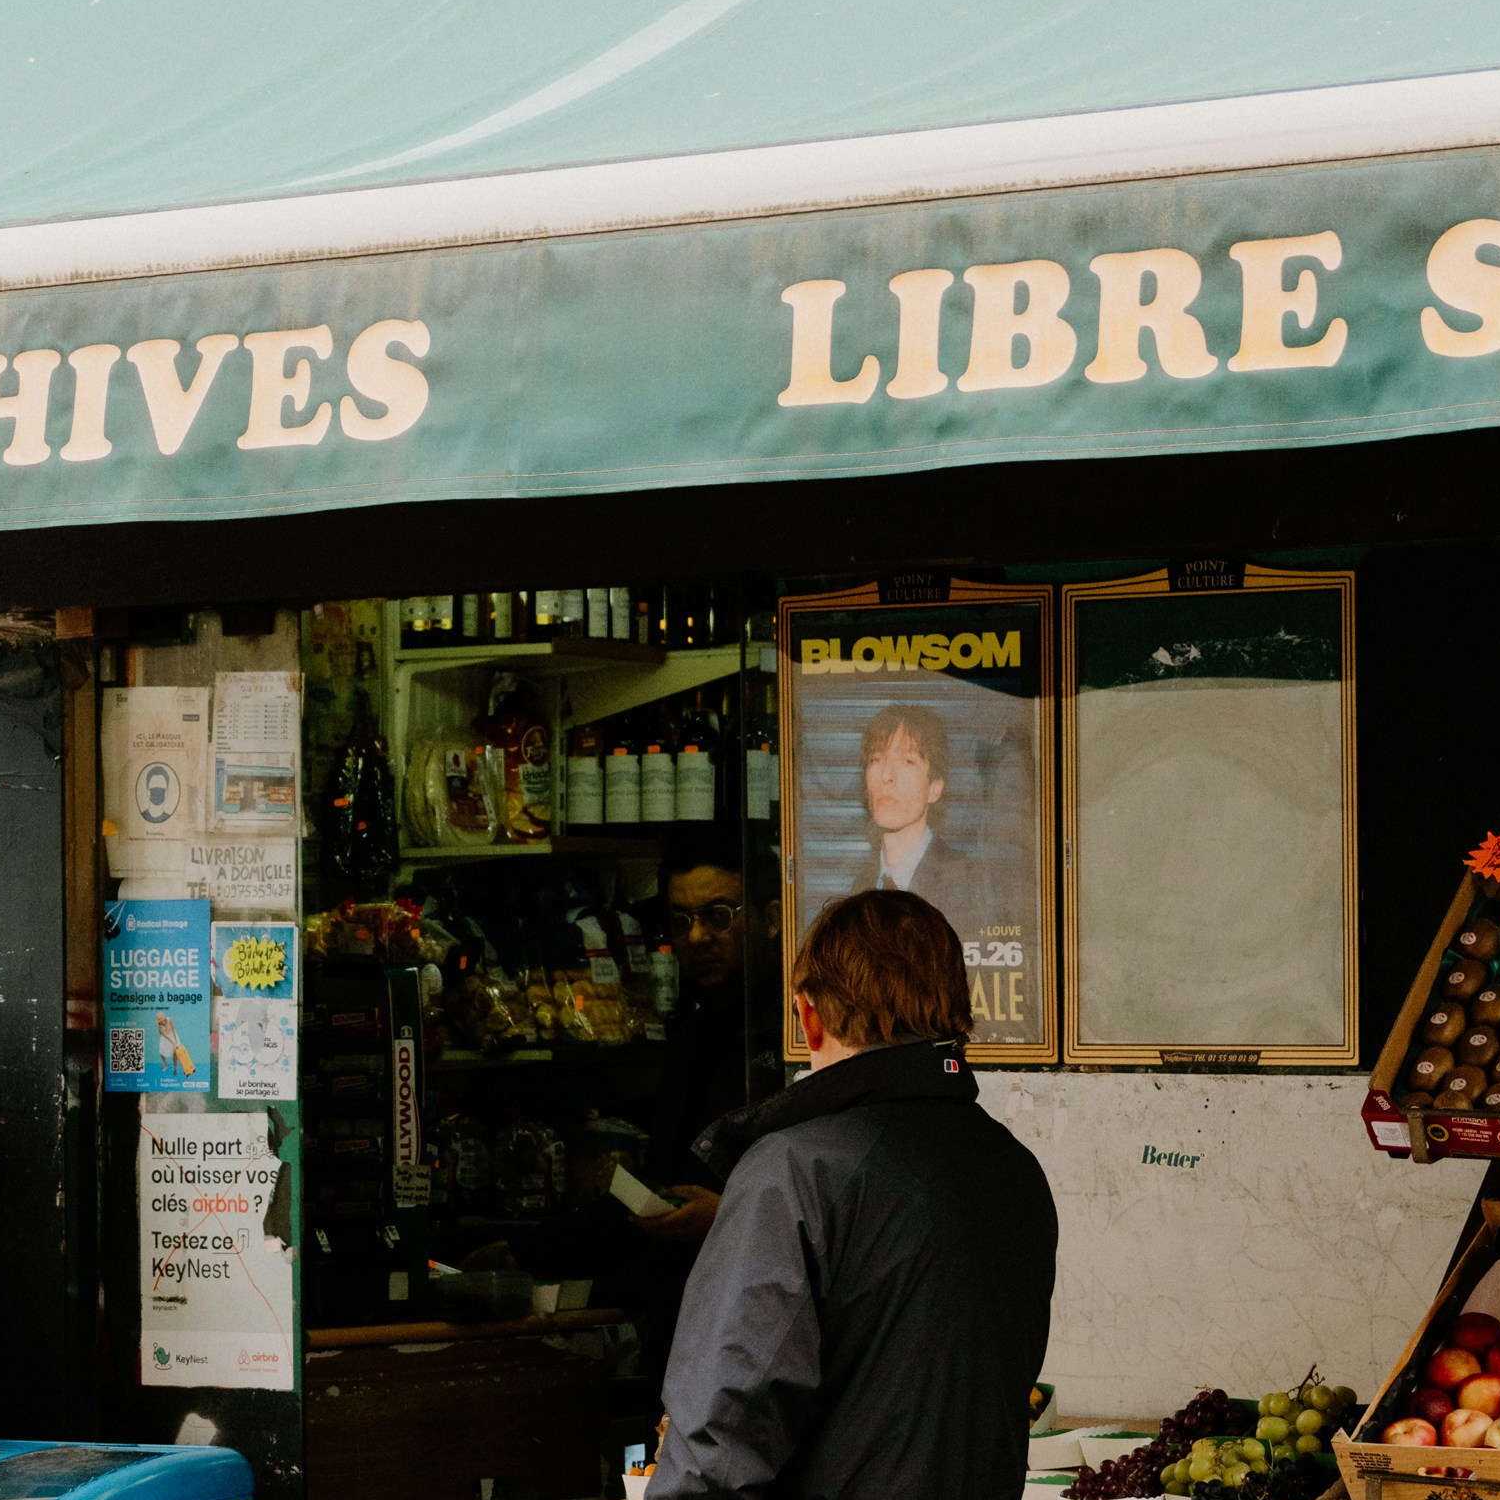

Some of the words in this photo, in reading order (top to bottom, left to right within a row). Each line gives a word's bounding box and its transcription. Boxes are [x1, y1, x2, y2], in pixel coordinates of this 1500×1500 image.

[777, 230, 1347, 407] LIBRE
[1185, 559, 1228, 574] POINT
[1177, 574, 1236, 589] CULTURE
[887, 588, 942, 601] CULTURE
[800, 631, 1021, 675] BLOWSOM
[191, 846, 265, 866] LIVRAISON
[231, 865, 292, 881] DOMICILE
[110, 948, 199, 968] LUGGAGE
[963, 942, 1023, 966] 5.26
[110, 969, 200, 989] STORAGE
[110, 992, 156, 1004] Consigne
[158, 991, 164, 1002] à
[167, 992, 203, 1004] bagage
[971, 971, 1024, 1021] ALE
[246, 1088, 271, 1097] partage
[248, 1080, 277, 1089] bonheur
[152, 1137, 197, 1156] Nulle
[203, 1138, 242, 1161] part
[1141, 1145, 1200, 1168] Better
[151, 1165, 174, 1184] où
[180, 1166, 241, 1184] laisser
[246, 1170, 278, 1184] vos
[151, 1194, 187, 1213] clés
[192, 1193, 249, 1213] airbnb
[254, 1195, 262, 1213] ?
[152, 1231, 207, 1250] Testez
[212, 1234, 233, 1250] ce
[152, 1257, 230, 1283] KeyNest
[176, 1354, 208, 1365] KeyNest
[252, 1353, 278, 1362] airbnb
